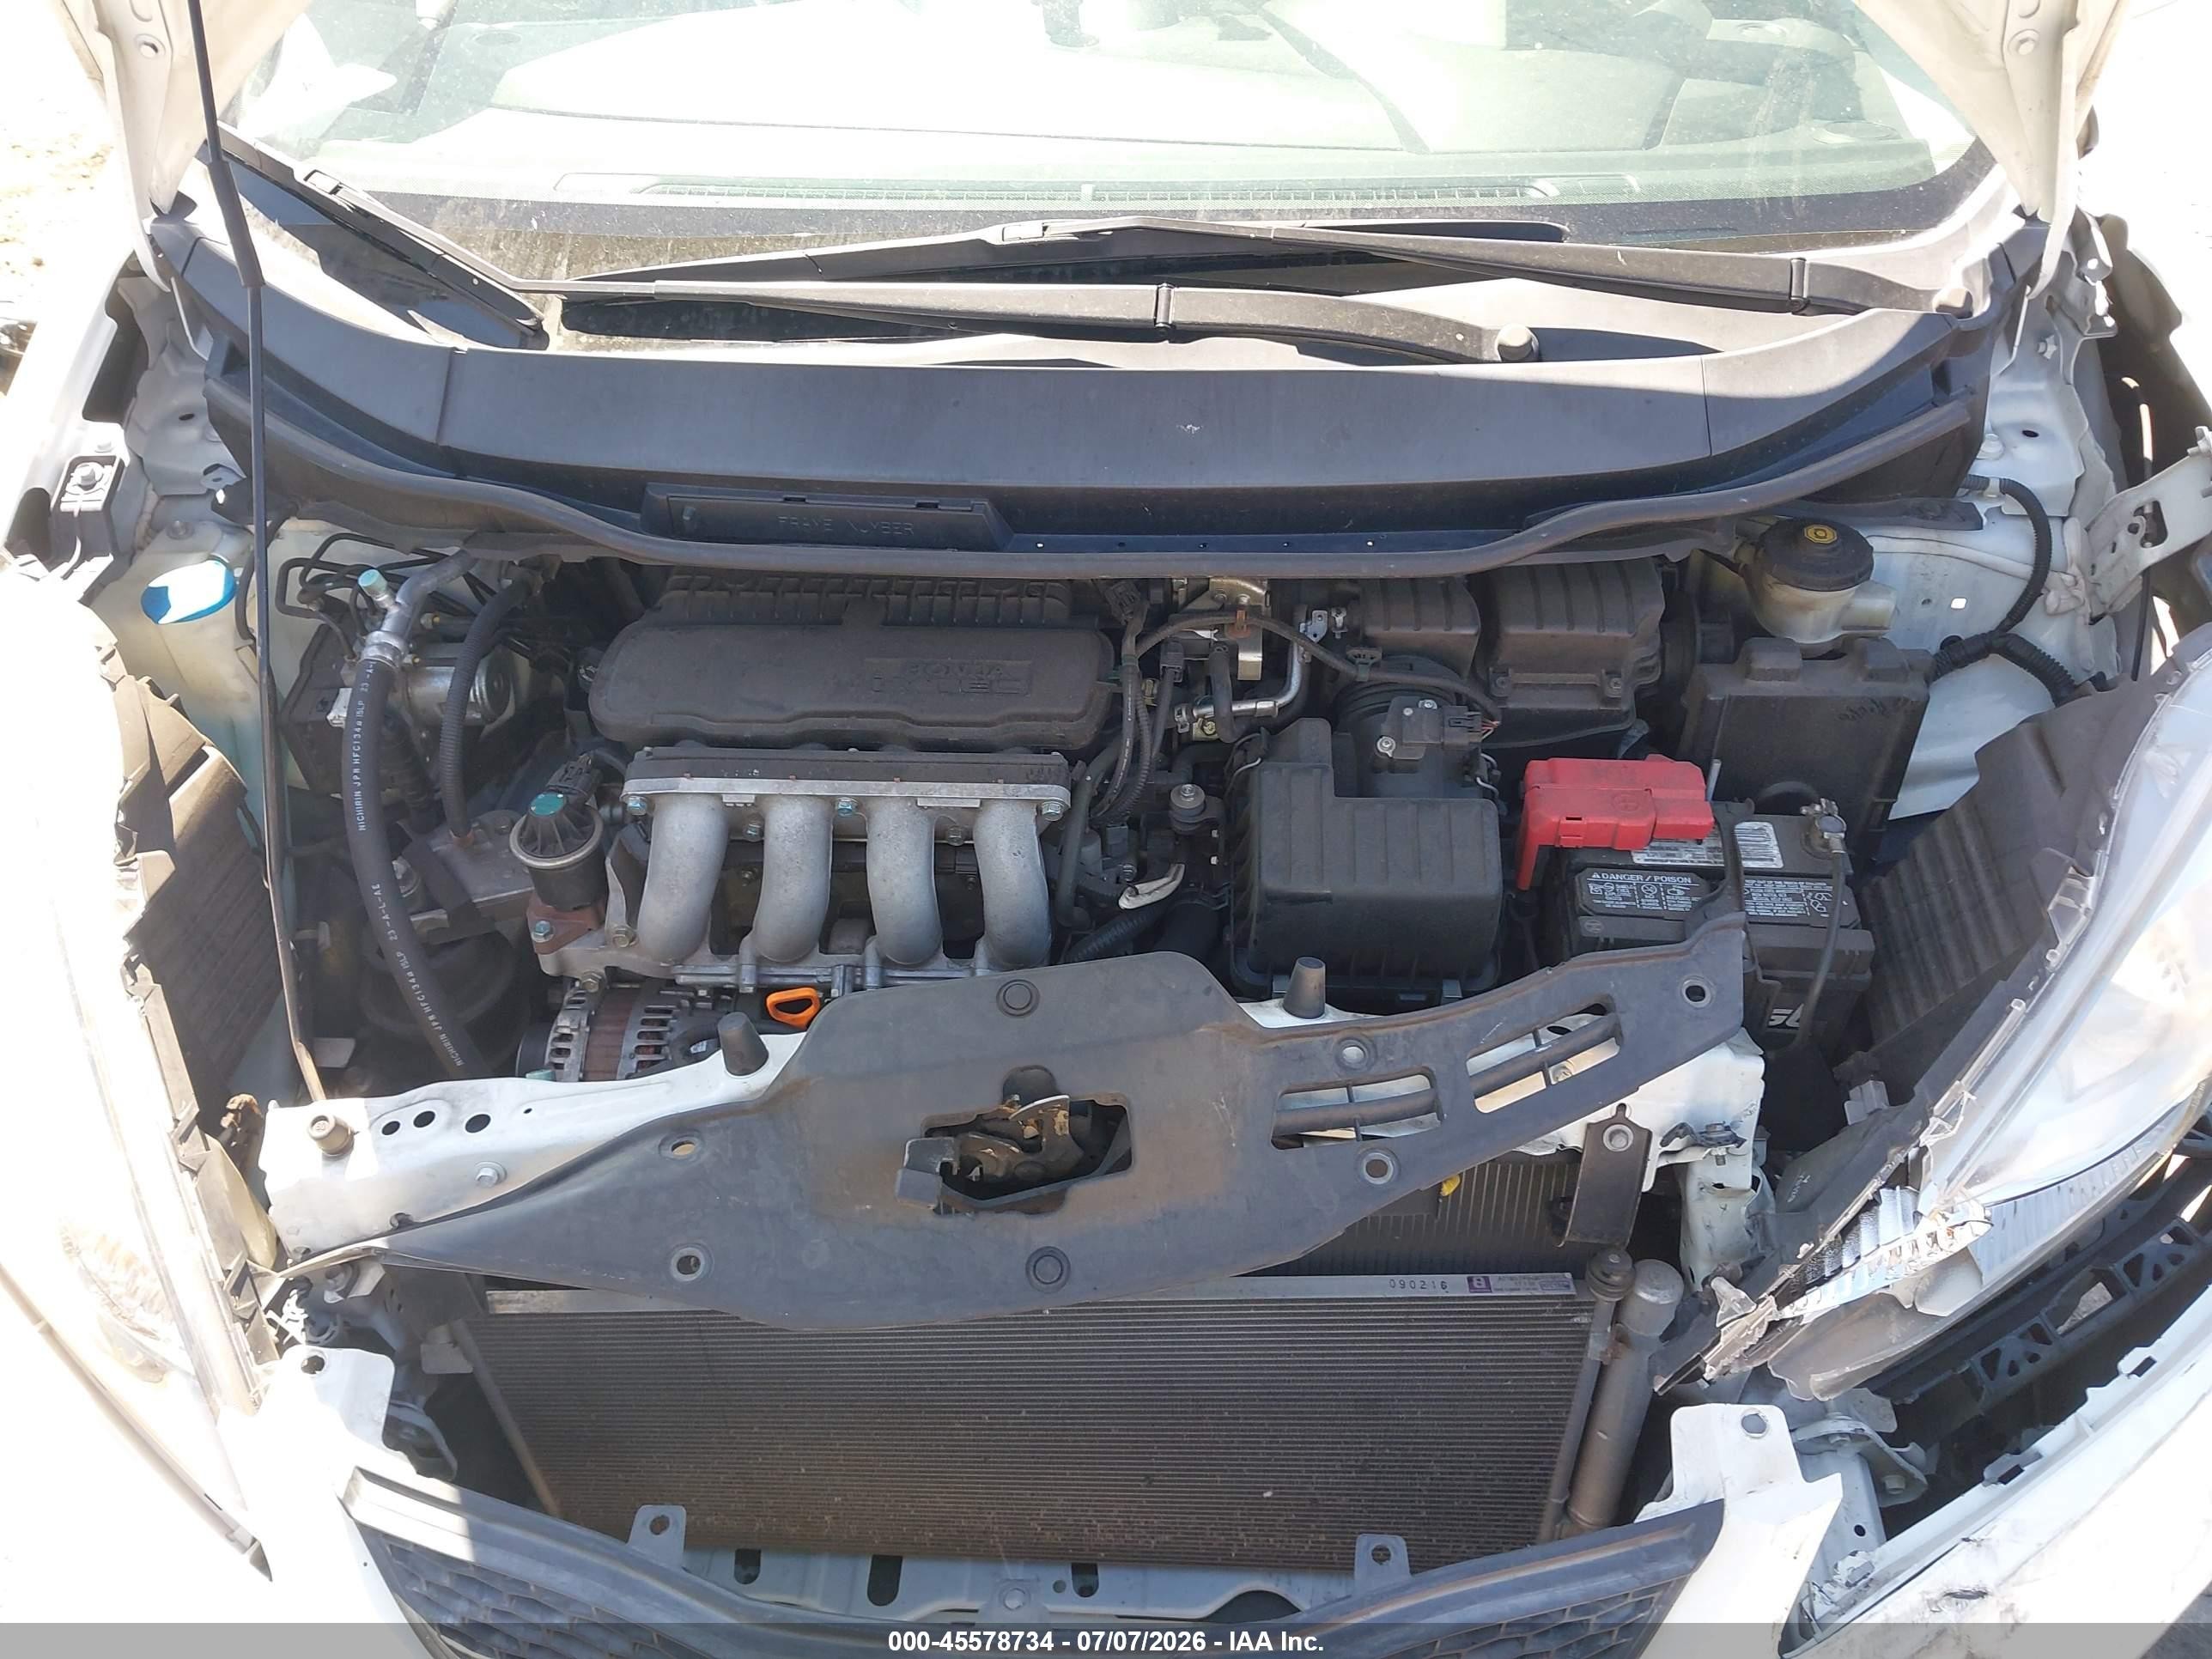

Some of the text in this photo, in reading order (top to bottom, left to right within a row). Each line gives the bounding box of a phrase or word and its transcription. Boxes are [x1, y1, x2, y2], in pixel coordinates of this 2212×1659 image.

[353, 790, 368, 832] NICHIRIN
[1601, 872, 1644, 882] DANGER
[1654, 874, 1692, 884] POISON
